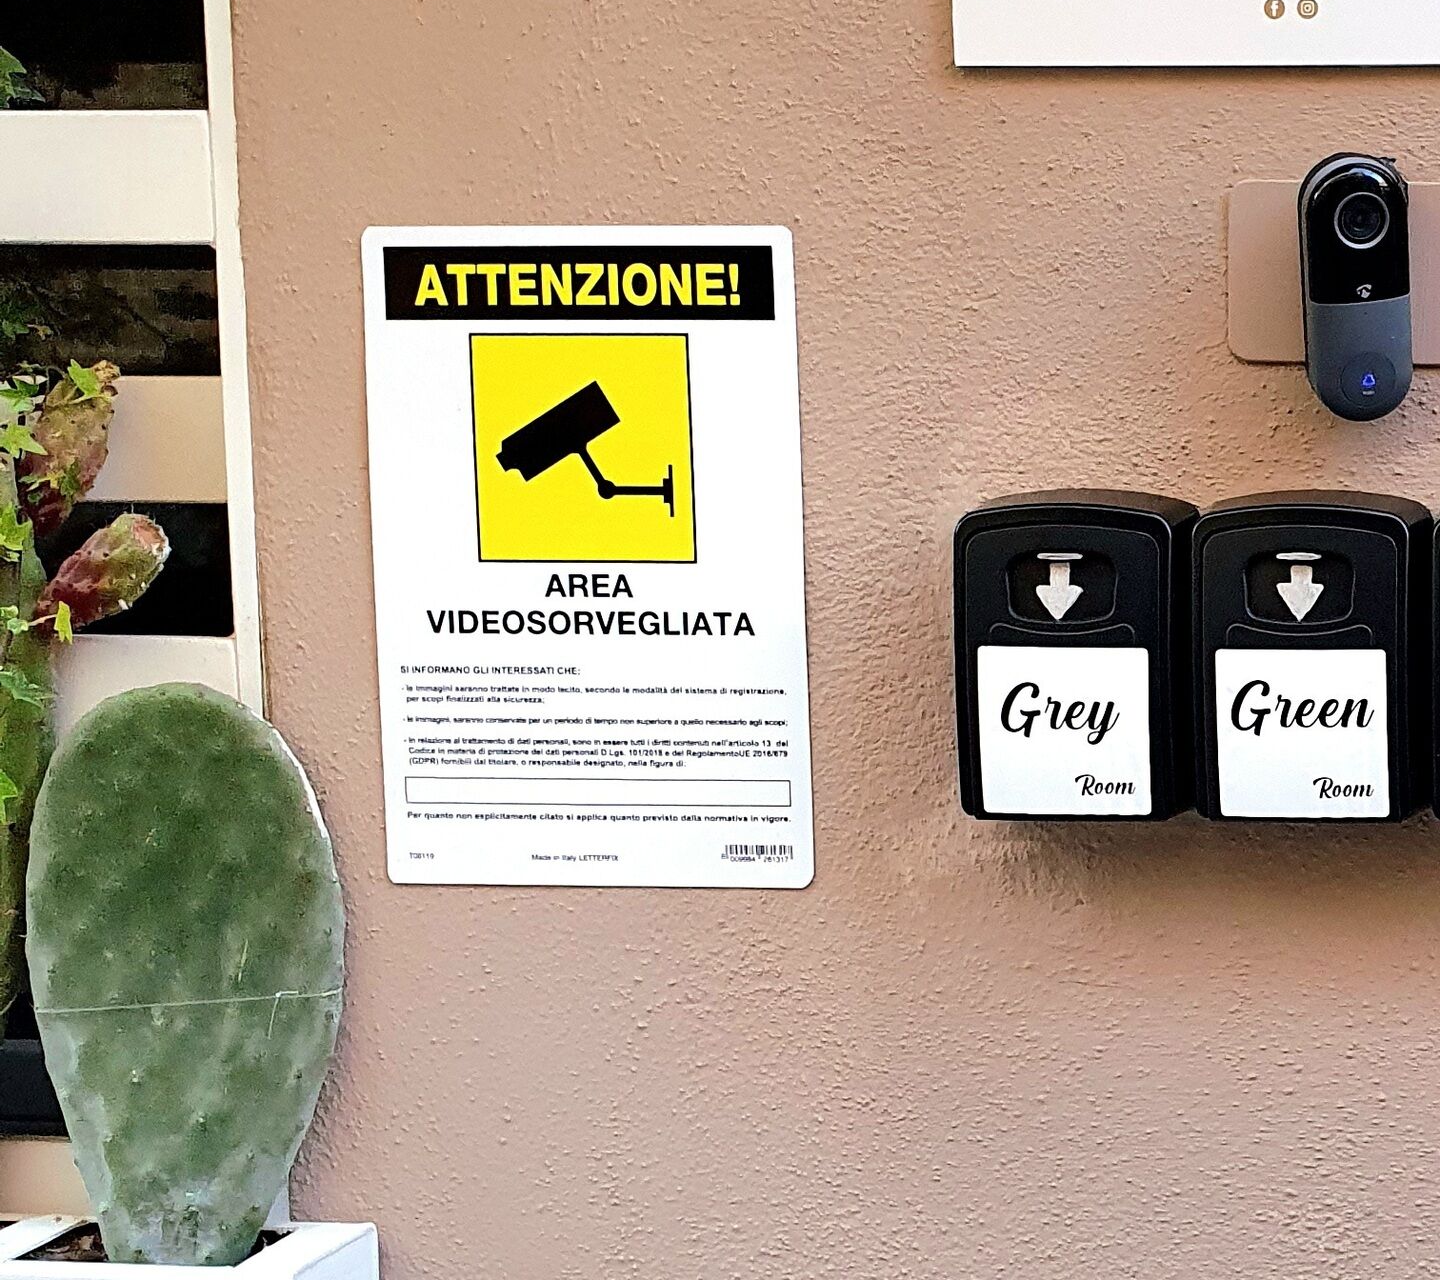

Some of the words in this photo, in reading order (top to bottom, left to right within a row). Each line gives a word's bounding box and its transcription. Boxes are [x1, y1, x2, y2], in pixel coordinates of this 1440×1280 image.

[414, 263, 742, 307] ATTENZIONE!
[545, 573, 634, 598] AREA
[426, 610, 756, 637] VIDEOSORVEGLIATA
[400, 665, 409, 674] SI
[412, 665, 470, 674] INFORMANO
[473, 666, 489, 675] GLI
[492, 666, 554, 675] INTERESSATI
[1000, 681, 1120, 746] Grey
[1230, 679, 1375, 737] Green
[1073, 773, 1136, 797] Room
[1312, 775, 1375, 800] Room
[424, 812, 454, 820] quanto
[474, 813, 537, 821] esplicitamente
[576, 814, 607, 822] applica
[610, 814, 640, 822] quanto
[642, 814, 678, 822] previsto
[761, 815, 791, 824] vigore.
